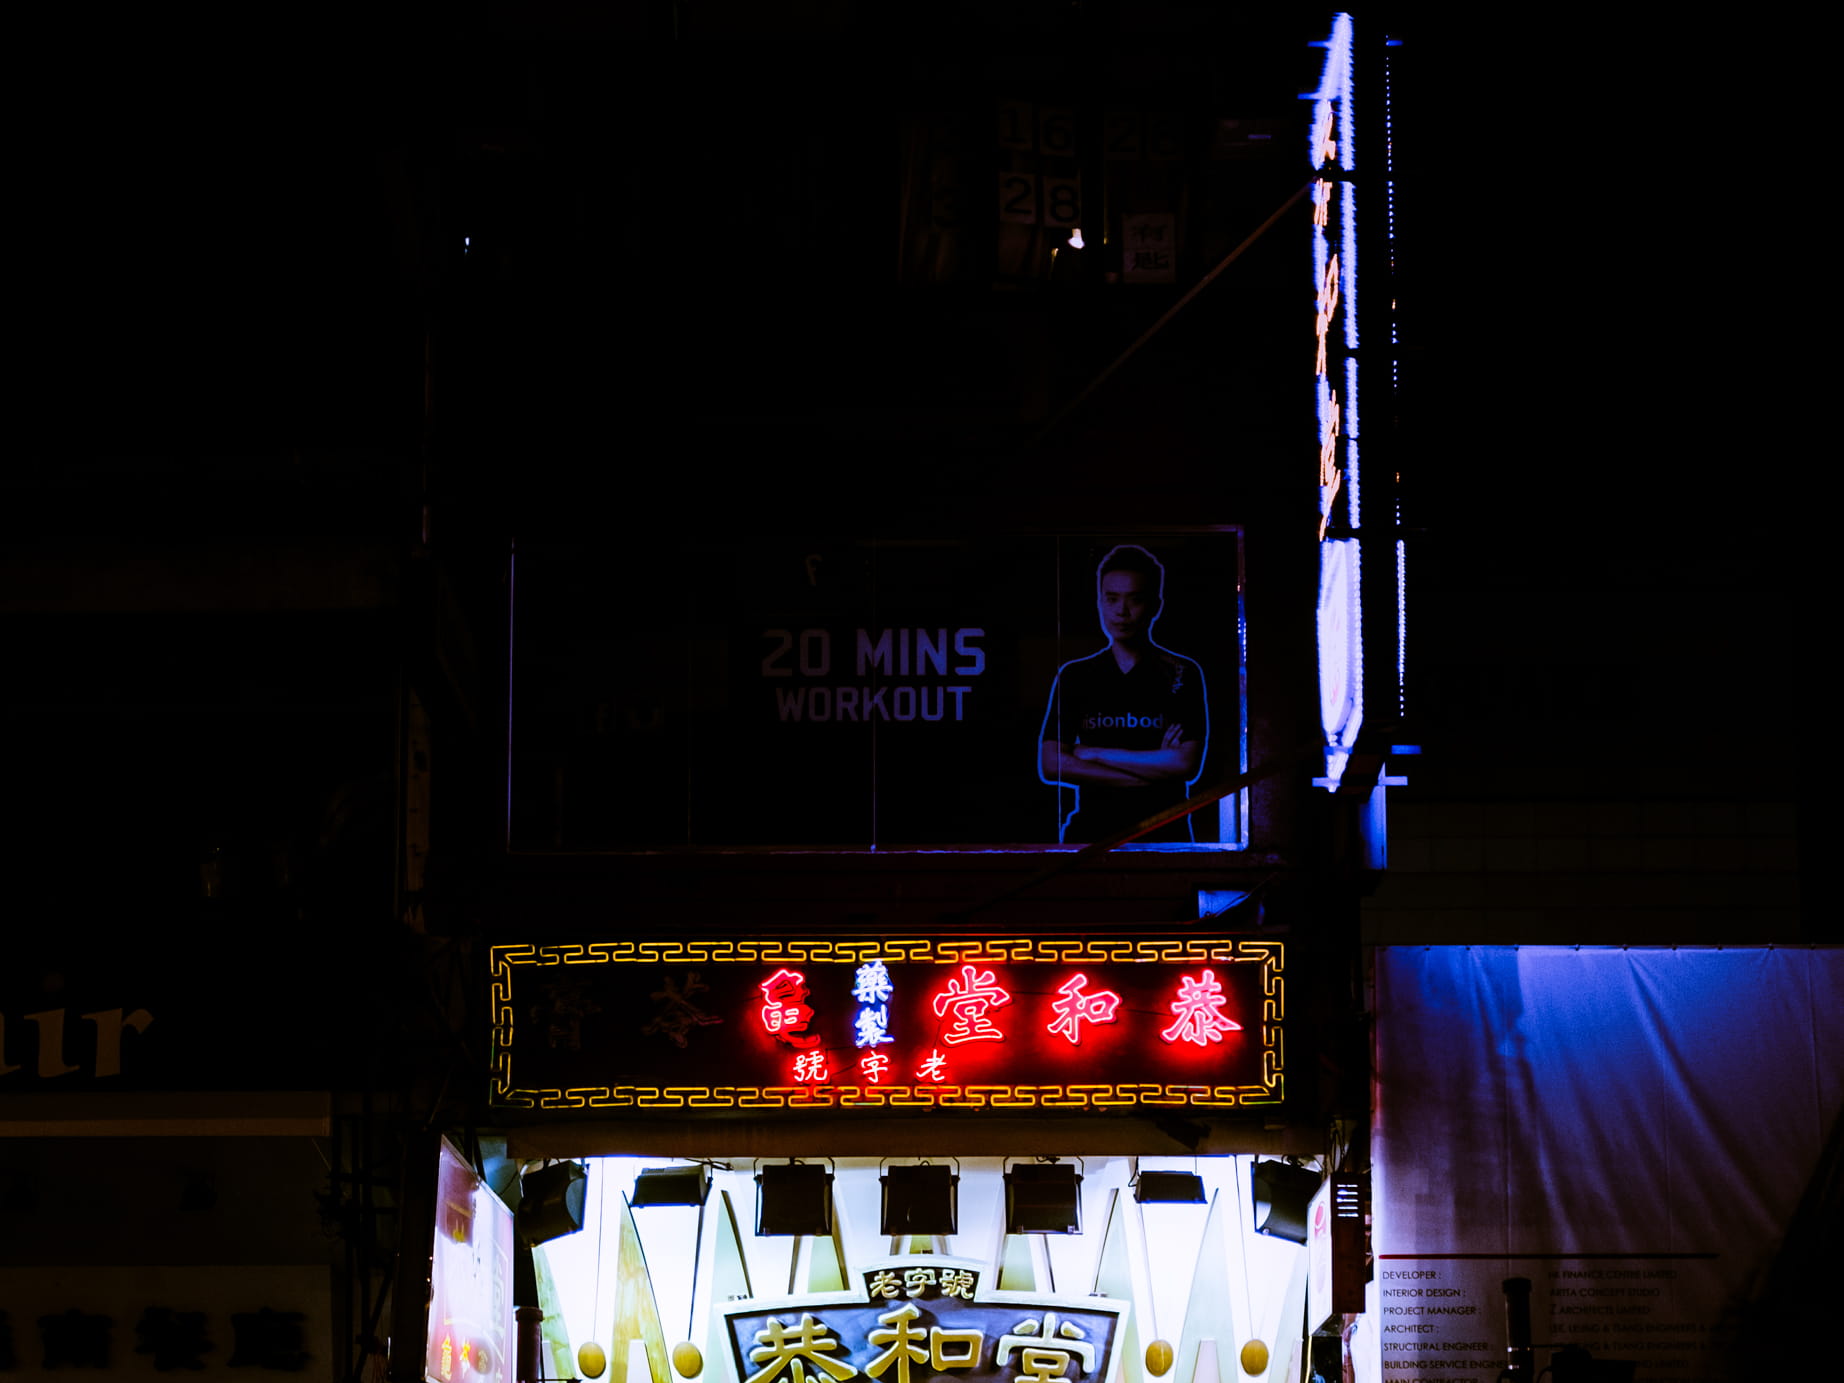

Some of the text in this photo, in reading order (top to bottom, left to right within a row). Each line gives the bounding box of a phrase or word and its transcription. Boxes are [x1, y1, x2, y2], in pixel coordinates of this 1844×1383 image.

[1003, 175, 1081, 223] 28
[760, 626, 987, 678] 20 MINS
[775, 684, 973, 723] WORKOUT
[1382, 1271, 1437, 1280] DEVELOPER
[869, 1267, 975, 1300] 老字號
[1383, 1289, 1424, 1298] INTERIOR
[1425, 1289, 1461, 1298] DESIGN
[1383, 1306, 1425, 1316] PROJECT
[1427, 1306, 1477, 1316] MANAGER
[1384, 1324, 1435, 1333] ARCHITECT
[1384, 1342, 1440, 1351] STRUCTURAL
[1443, 1342, 1489, 1351] ENGINEER
[1384, 1360, 1428, 1369] BUILDING
[1429, 1360, 1468, 1369] SERVICE
